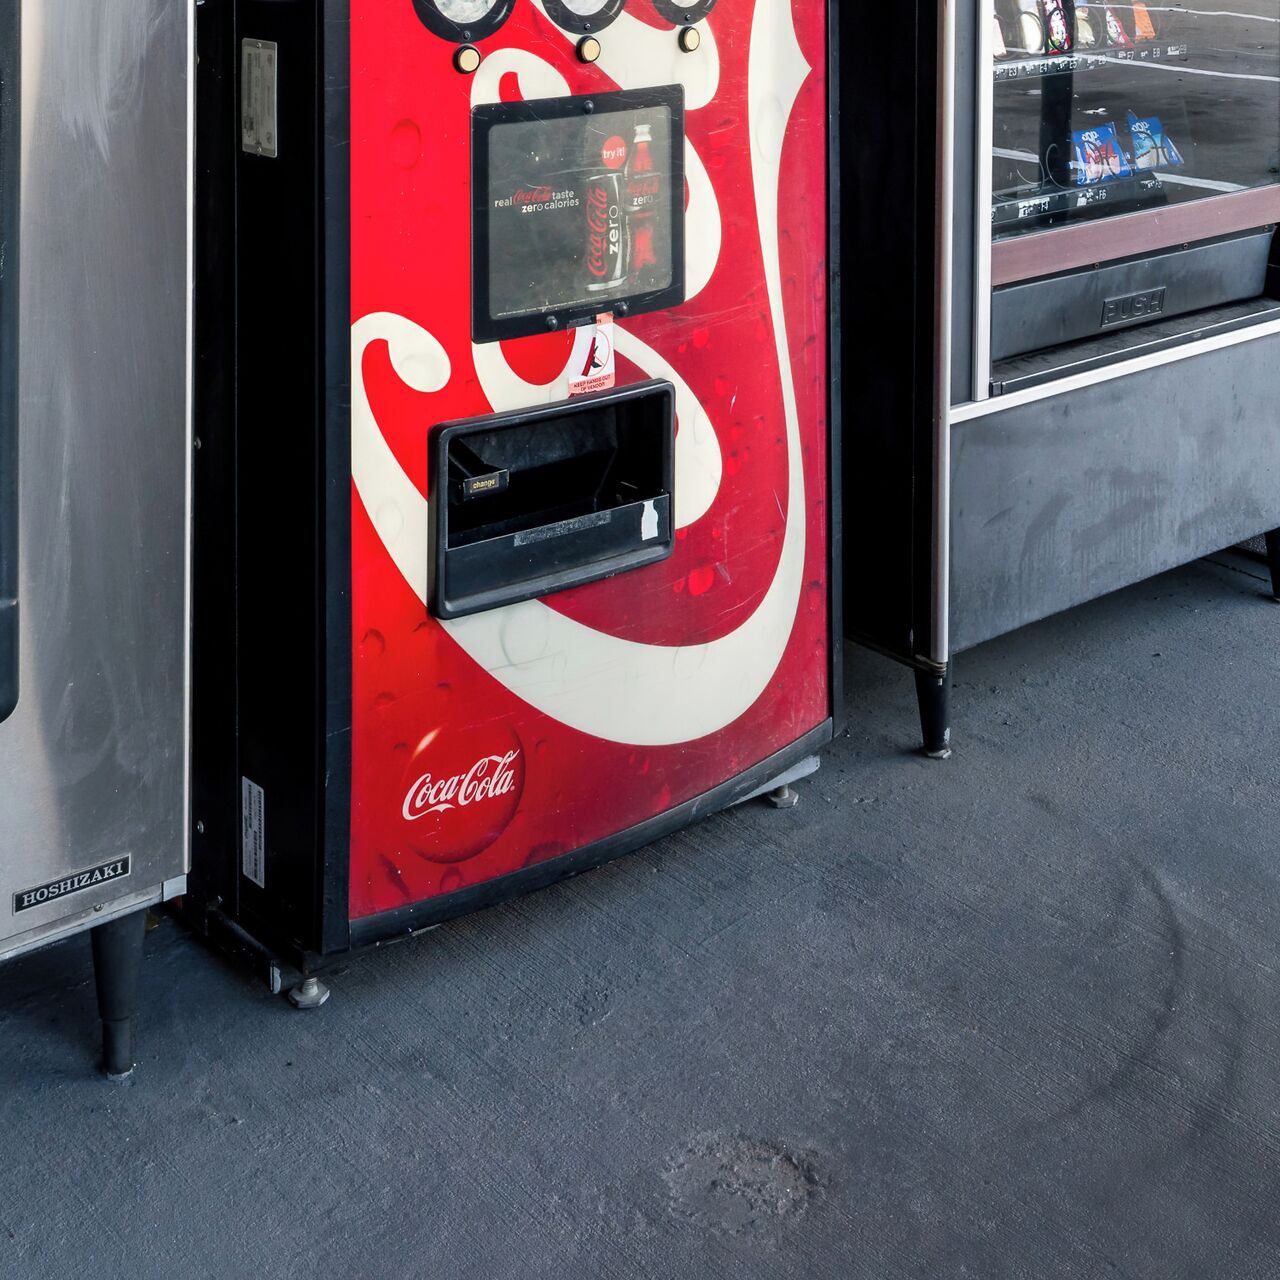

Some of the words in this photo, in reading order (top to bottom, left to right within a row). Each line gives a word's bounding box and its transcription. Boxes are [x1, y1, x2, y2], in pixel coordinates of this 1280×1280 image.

[603, 149, 616, 160] try
[494, 196, 513, 208] real
[552, 190, 575, 200] taste
[521, 203, 543, 213] zero
[544, 198, 580, 210] calories
[632, 195, 653, 206] zero
[609, 205, 619, 255] zero
[1104, 291, 1162, 323] PUSH
[573, 379, 587, 388] KEEP
[586, 377, 602, 385] HANDS
[472, 479, 496, 489] change
[402, 748, 520, 821] Coca-Cola
[21, 861, 123, 907] HOSHIZAKI
